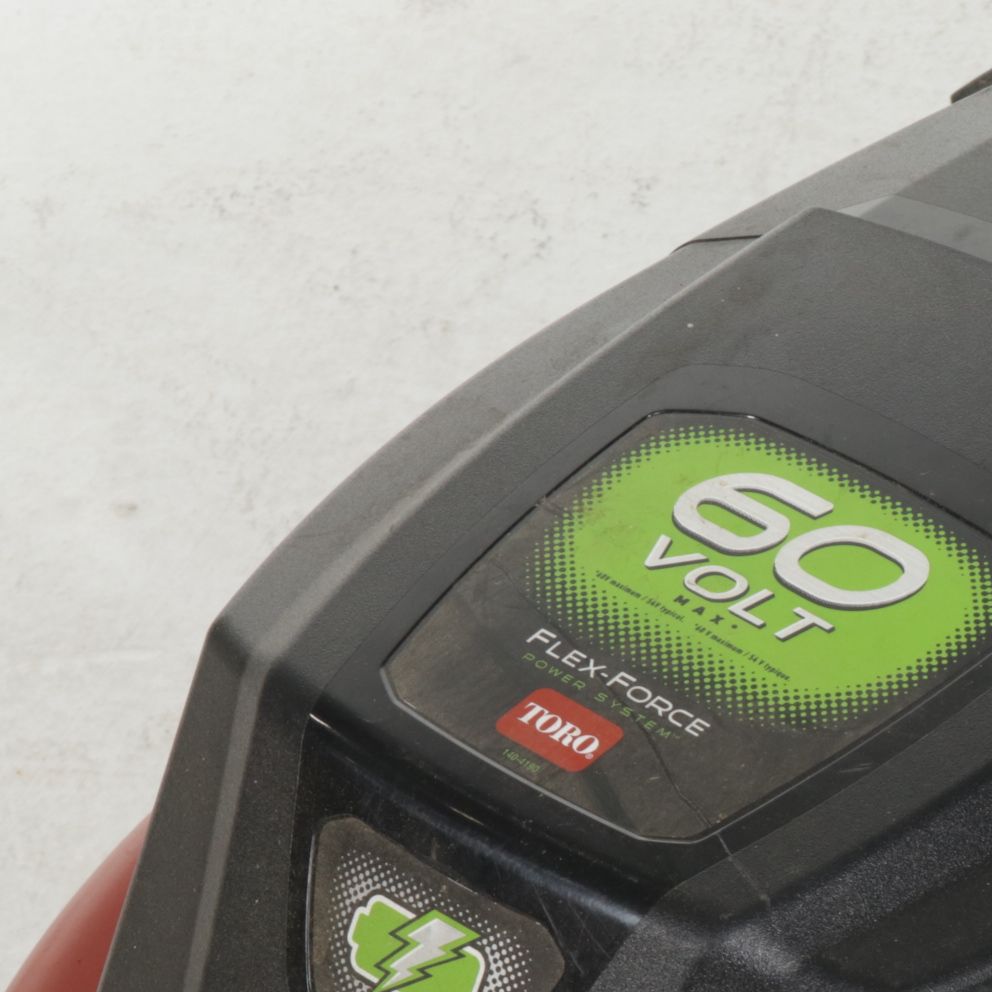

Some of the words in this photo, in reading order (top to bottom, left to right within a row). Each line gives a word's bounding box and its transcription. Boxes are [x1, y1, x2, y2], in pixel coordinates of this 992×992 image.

[643, 533, 836, 641] VOLT
[672, 471, 931, 611] 60
[521, 652, 586, 691] POWER
[525, 627, 711, 738] FLEX-FORCE
